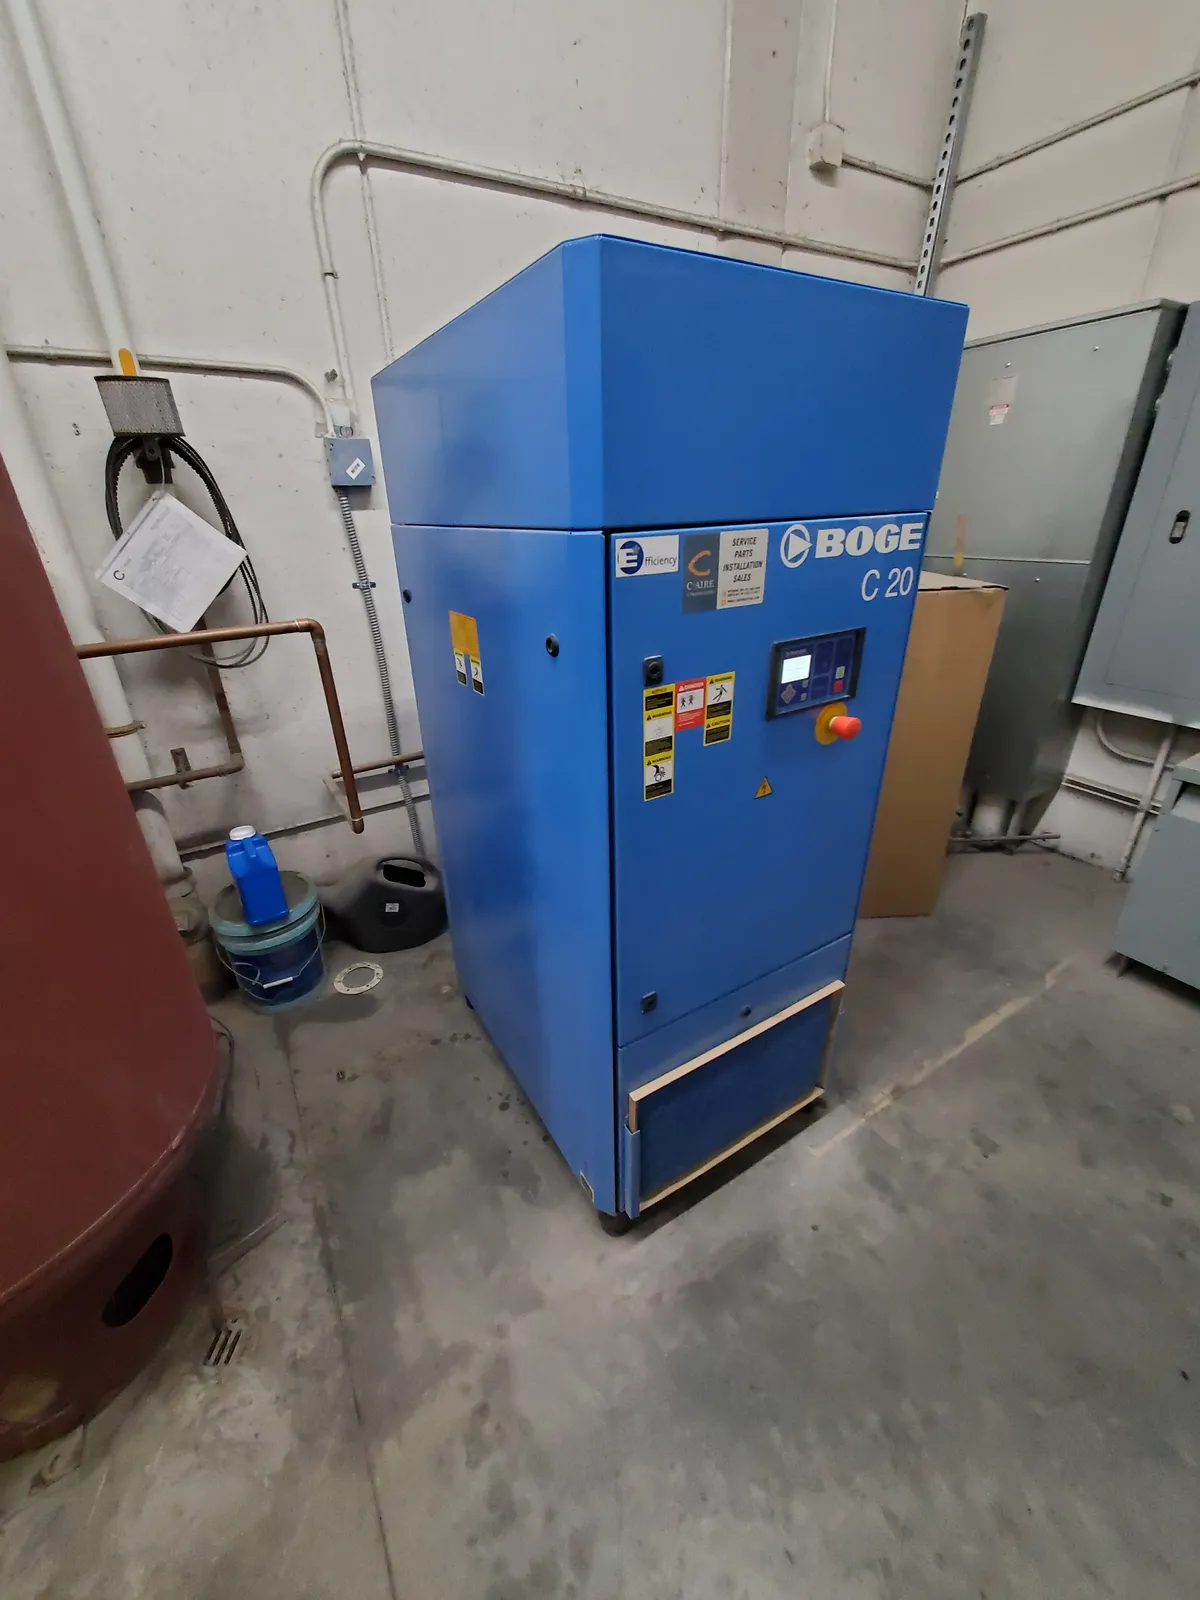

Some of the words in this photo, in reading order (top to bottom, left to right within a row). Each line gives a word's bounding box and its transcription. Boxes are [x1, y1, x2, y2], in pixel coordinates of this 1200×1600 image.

[732, 536, 757, 547] SERVICE
[815, 523, 924, 558] BOGE
[734, 549, 753, 558] PARTS
[723, 560, 763, 571] INSTALLATION
[733, 573, 751, 583] SALES
[861, 568, 880, 601] C
[885, 566, 914, 598] 20
